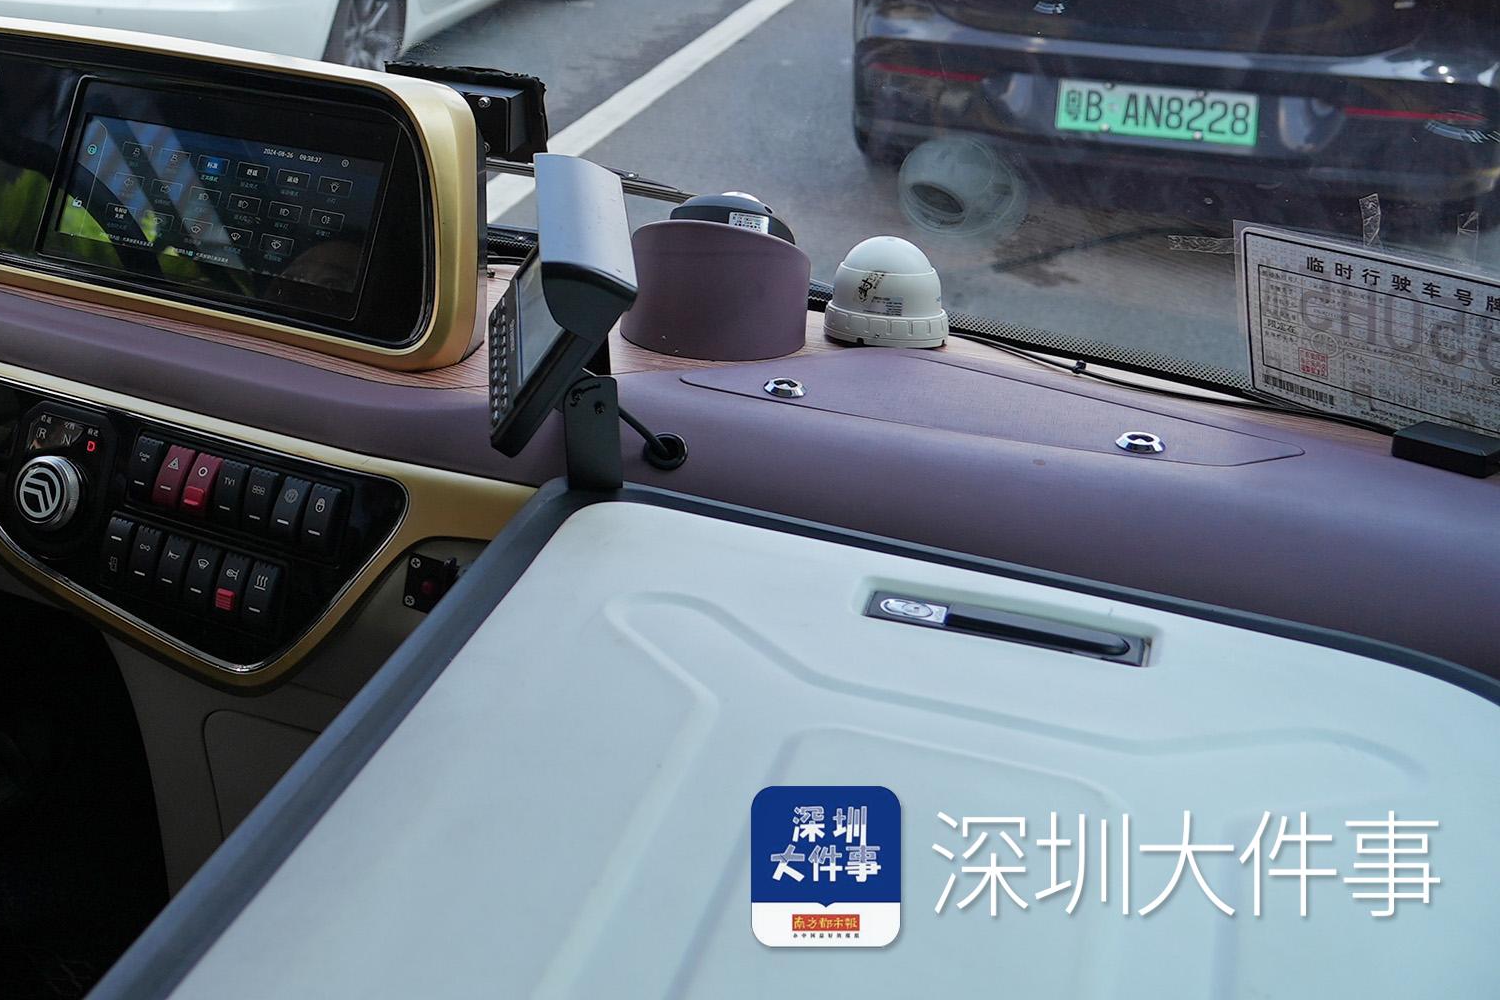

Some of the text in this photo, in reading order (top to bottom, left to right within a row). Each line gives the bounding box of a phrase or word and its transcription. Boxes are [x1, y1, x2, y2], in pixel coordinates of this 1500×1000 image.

[1122, 92, 1251, 136] AN8228
[1306, 255, 1500, 313] 临时行驶车号牌
[86, 440, 96, 452] D
